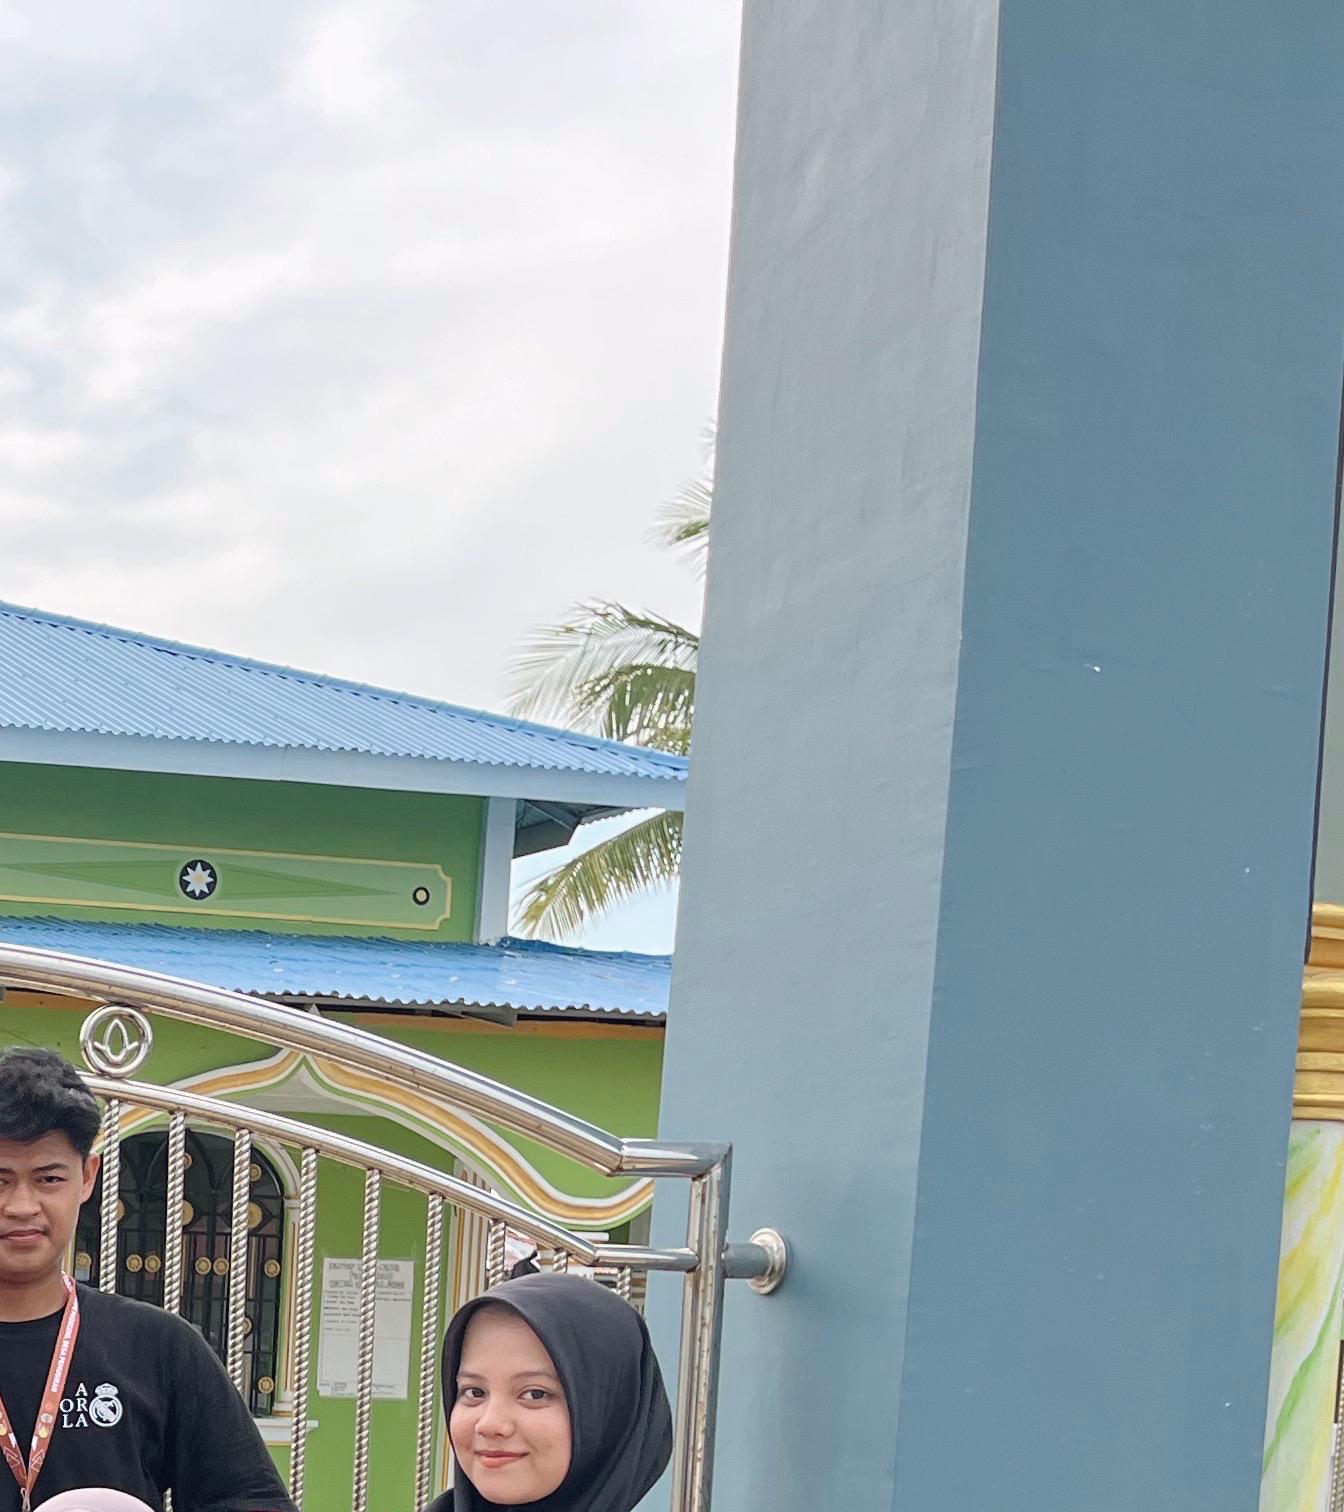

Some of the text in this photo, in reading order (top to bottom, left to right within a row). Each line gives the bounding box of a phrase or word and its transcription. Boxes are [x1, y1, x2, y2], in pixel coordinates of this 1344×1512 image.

[75, 1382, 88, 1397] A
[59, 1397, 89, 1413] OR
[62, 1412, 89, 1428] LA
